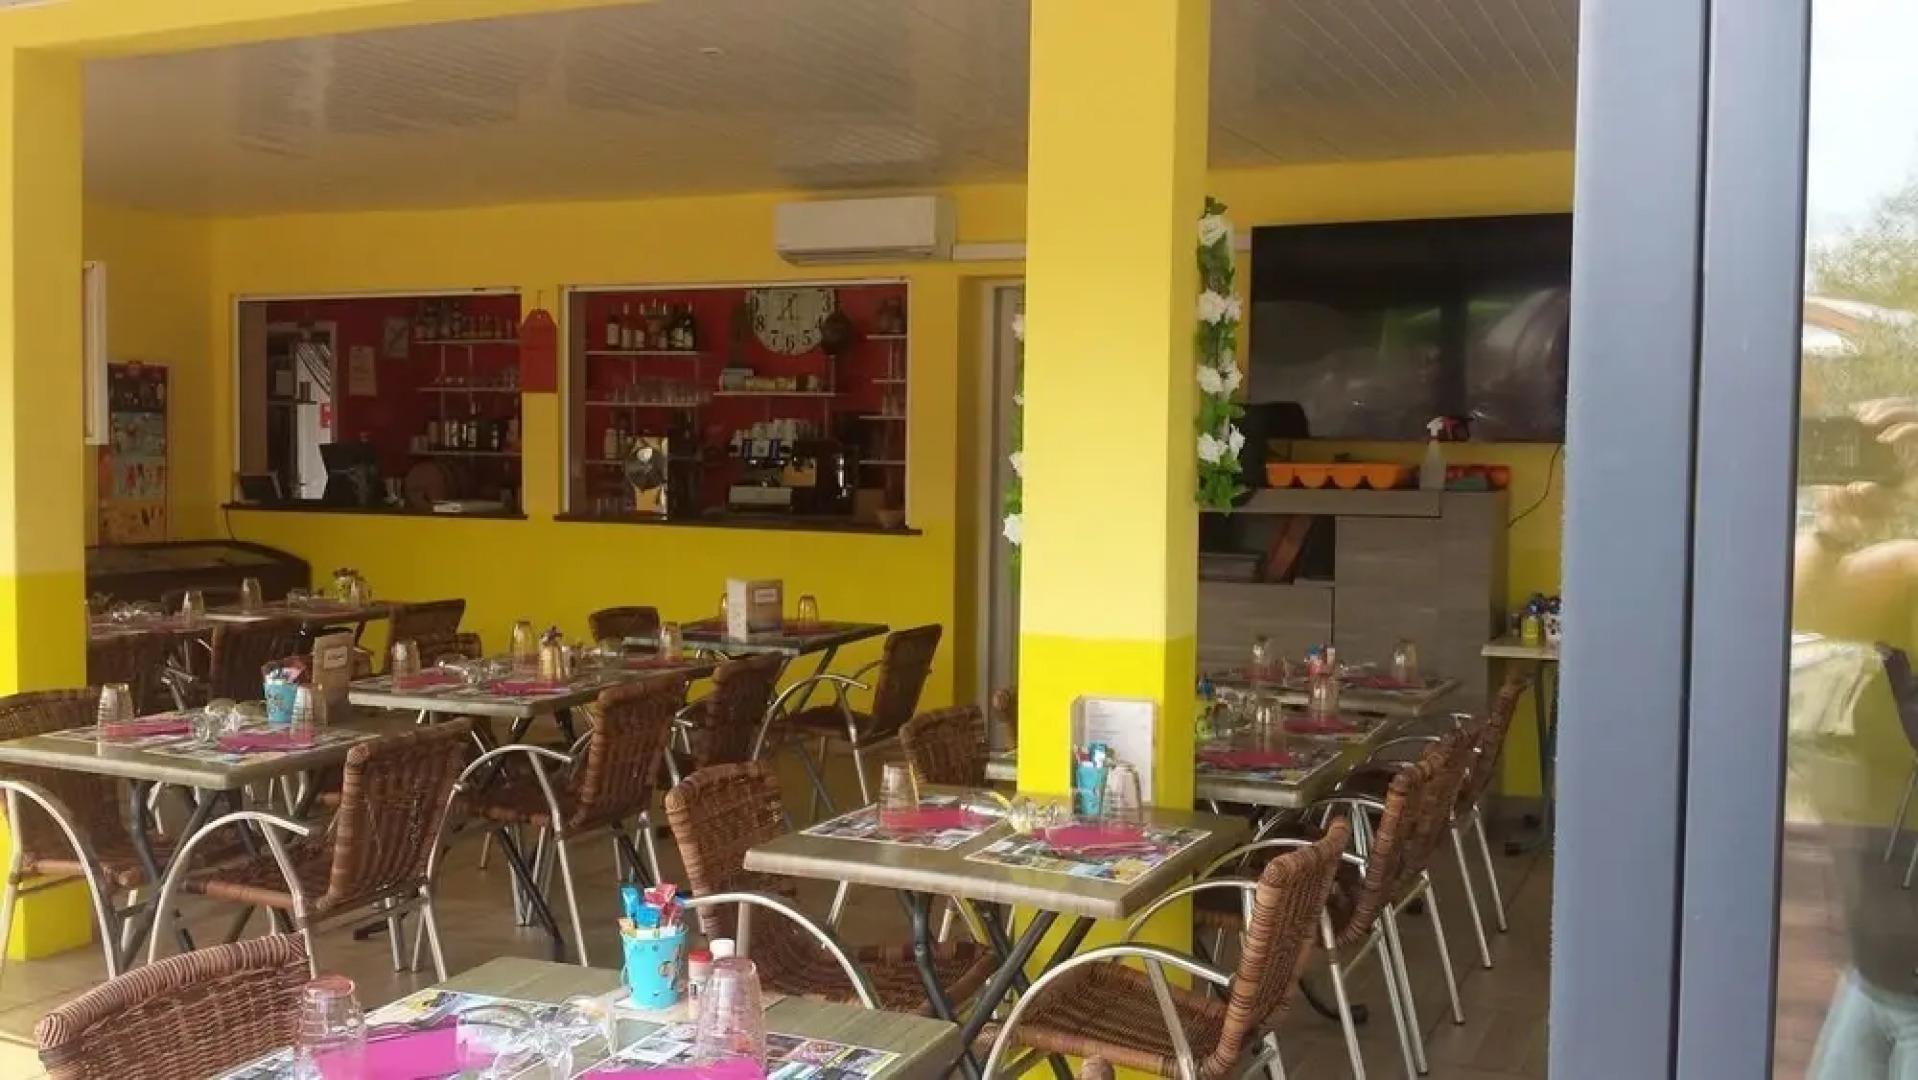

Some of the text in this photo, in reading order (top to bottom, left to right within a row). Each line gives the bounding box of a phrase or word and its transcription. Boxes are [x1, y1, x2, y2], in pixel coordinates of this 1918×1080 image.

[755, 314, 765, 331] 8
[770, 329, 779, 346] 7
[785, 334, 795, 353] 6
[802, 329, 812, 346] 5
